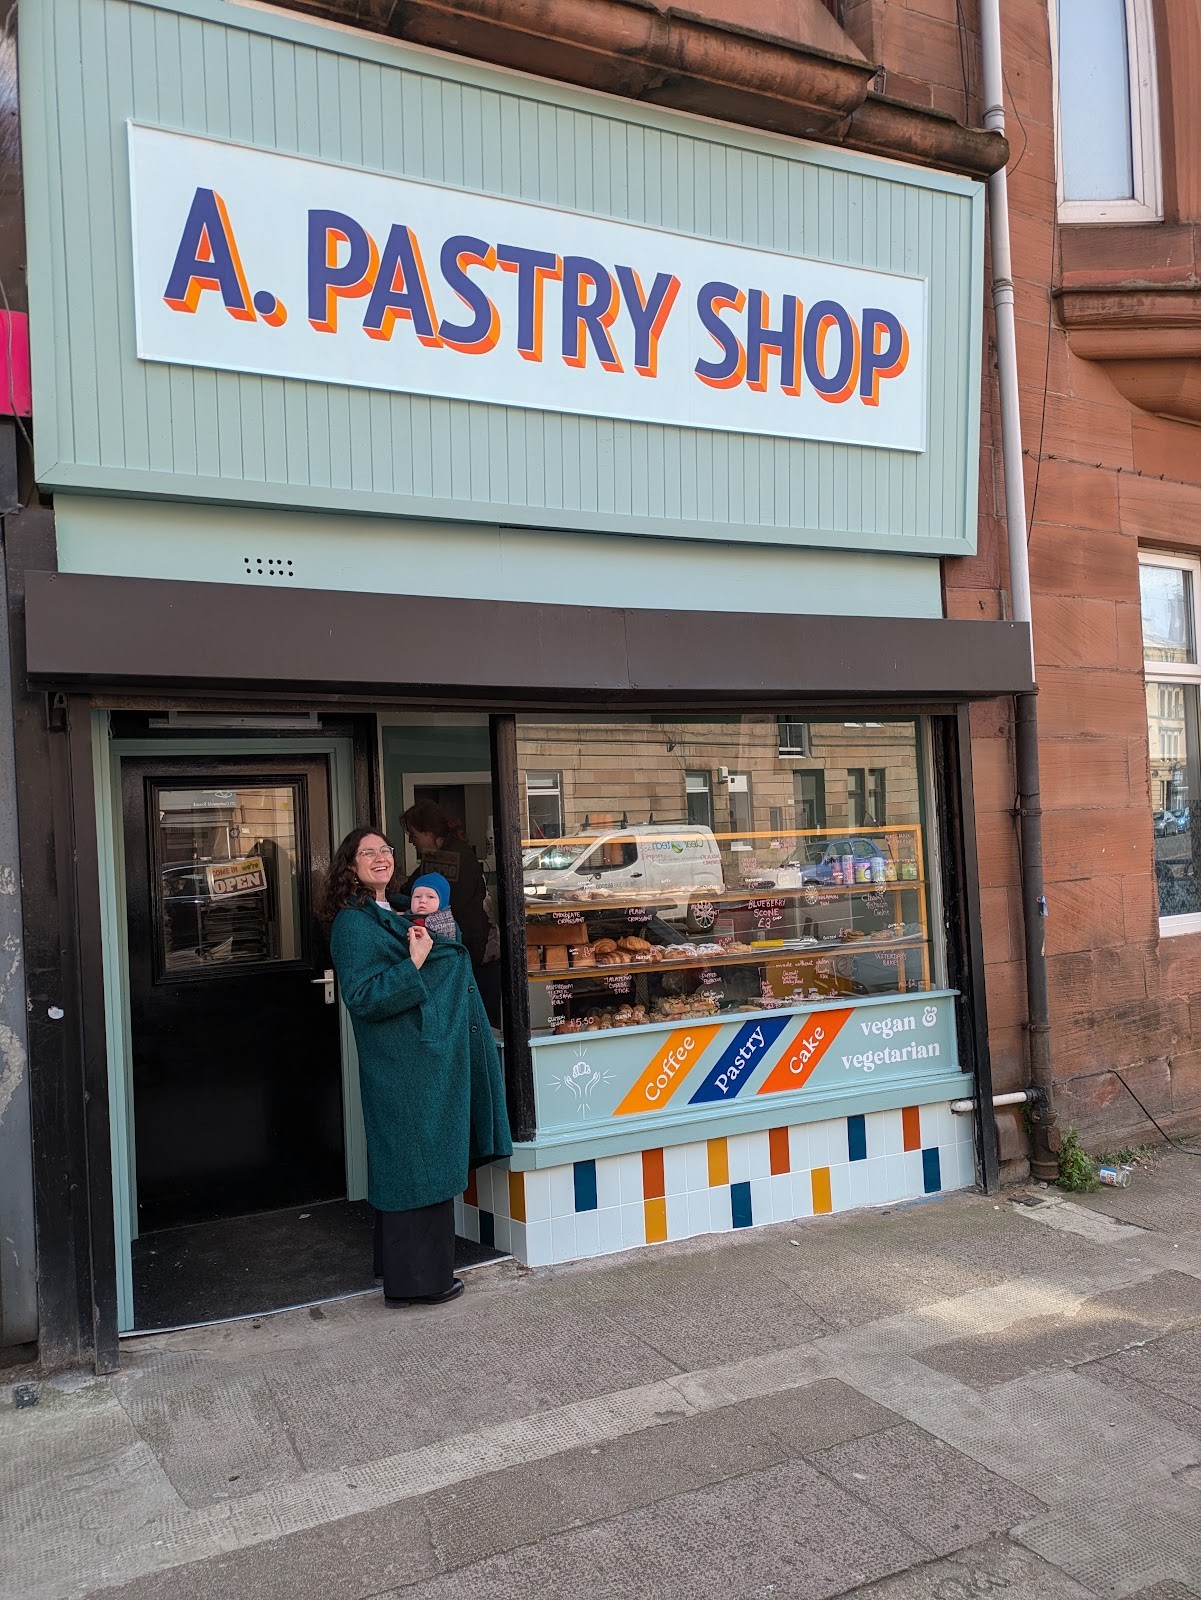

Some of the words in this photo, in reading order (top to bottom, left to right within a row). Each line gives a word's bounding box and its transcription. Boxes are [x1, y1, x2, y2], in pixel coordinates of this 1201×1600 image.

[163, 186, 287, 327] A.
[307, 208, 681, 379] PASTRY
[694, 281, 910, 407] SHOP
[212, 867, 231, 877] COME
[231, 866, 238, 874] IN
[214, 872, 261, 894] OPEN
[628, 908, 646, 916] PLAIN
[748, 898, 786, 909] BLUEBERRY
[753, 908, 780, 918] SCONE
[757, 917, 772, 929] £3
[860, 1015, 917, 1039] vegan
[921, 1005, 938, 1028] &
[714, 1025, 767, 1094] Pastry
[789, 1024, 826, 1076] Cake
[841, 1039, 941, 1073] vegetarian
[645, 1034, 696, 1102] Coffee
